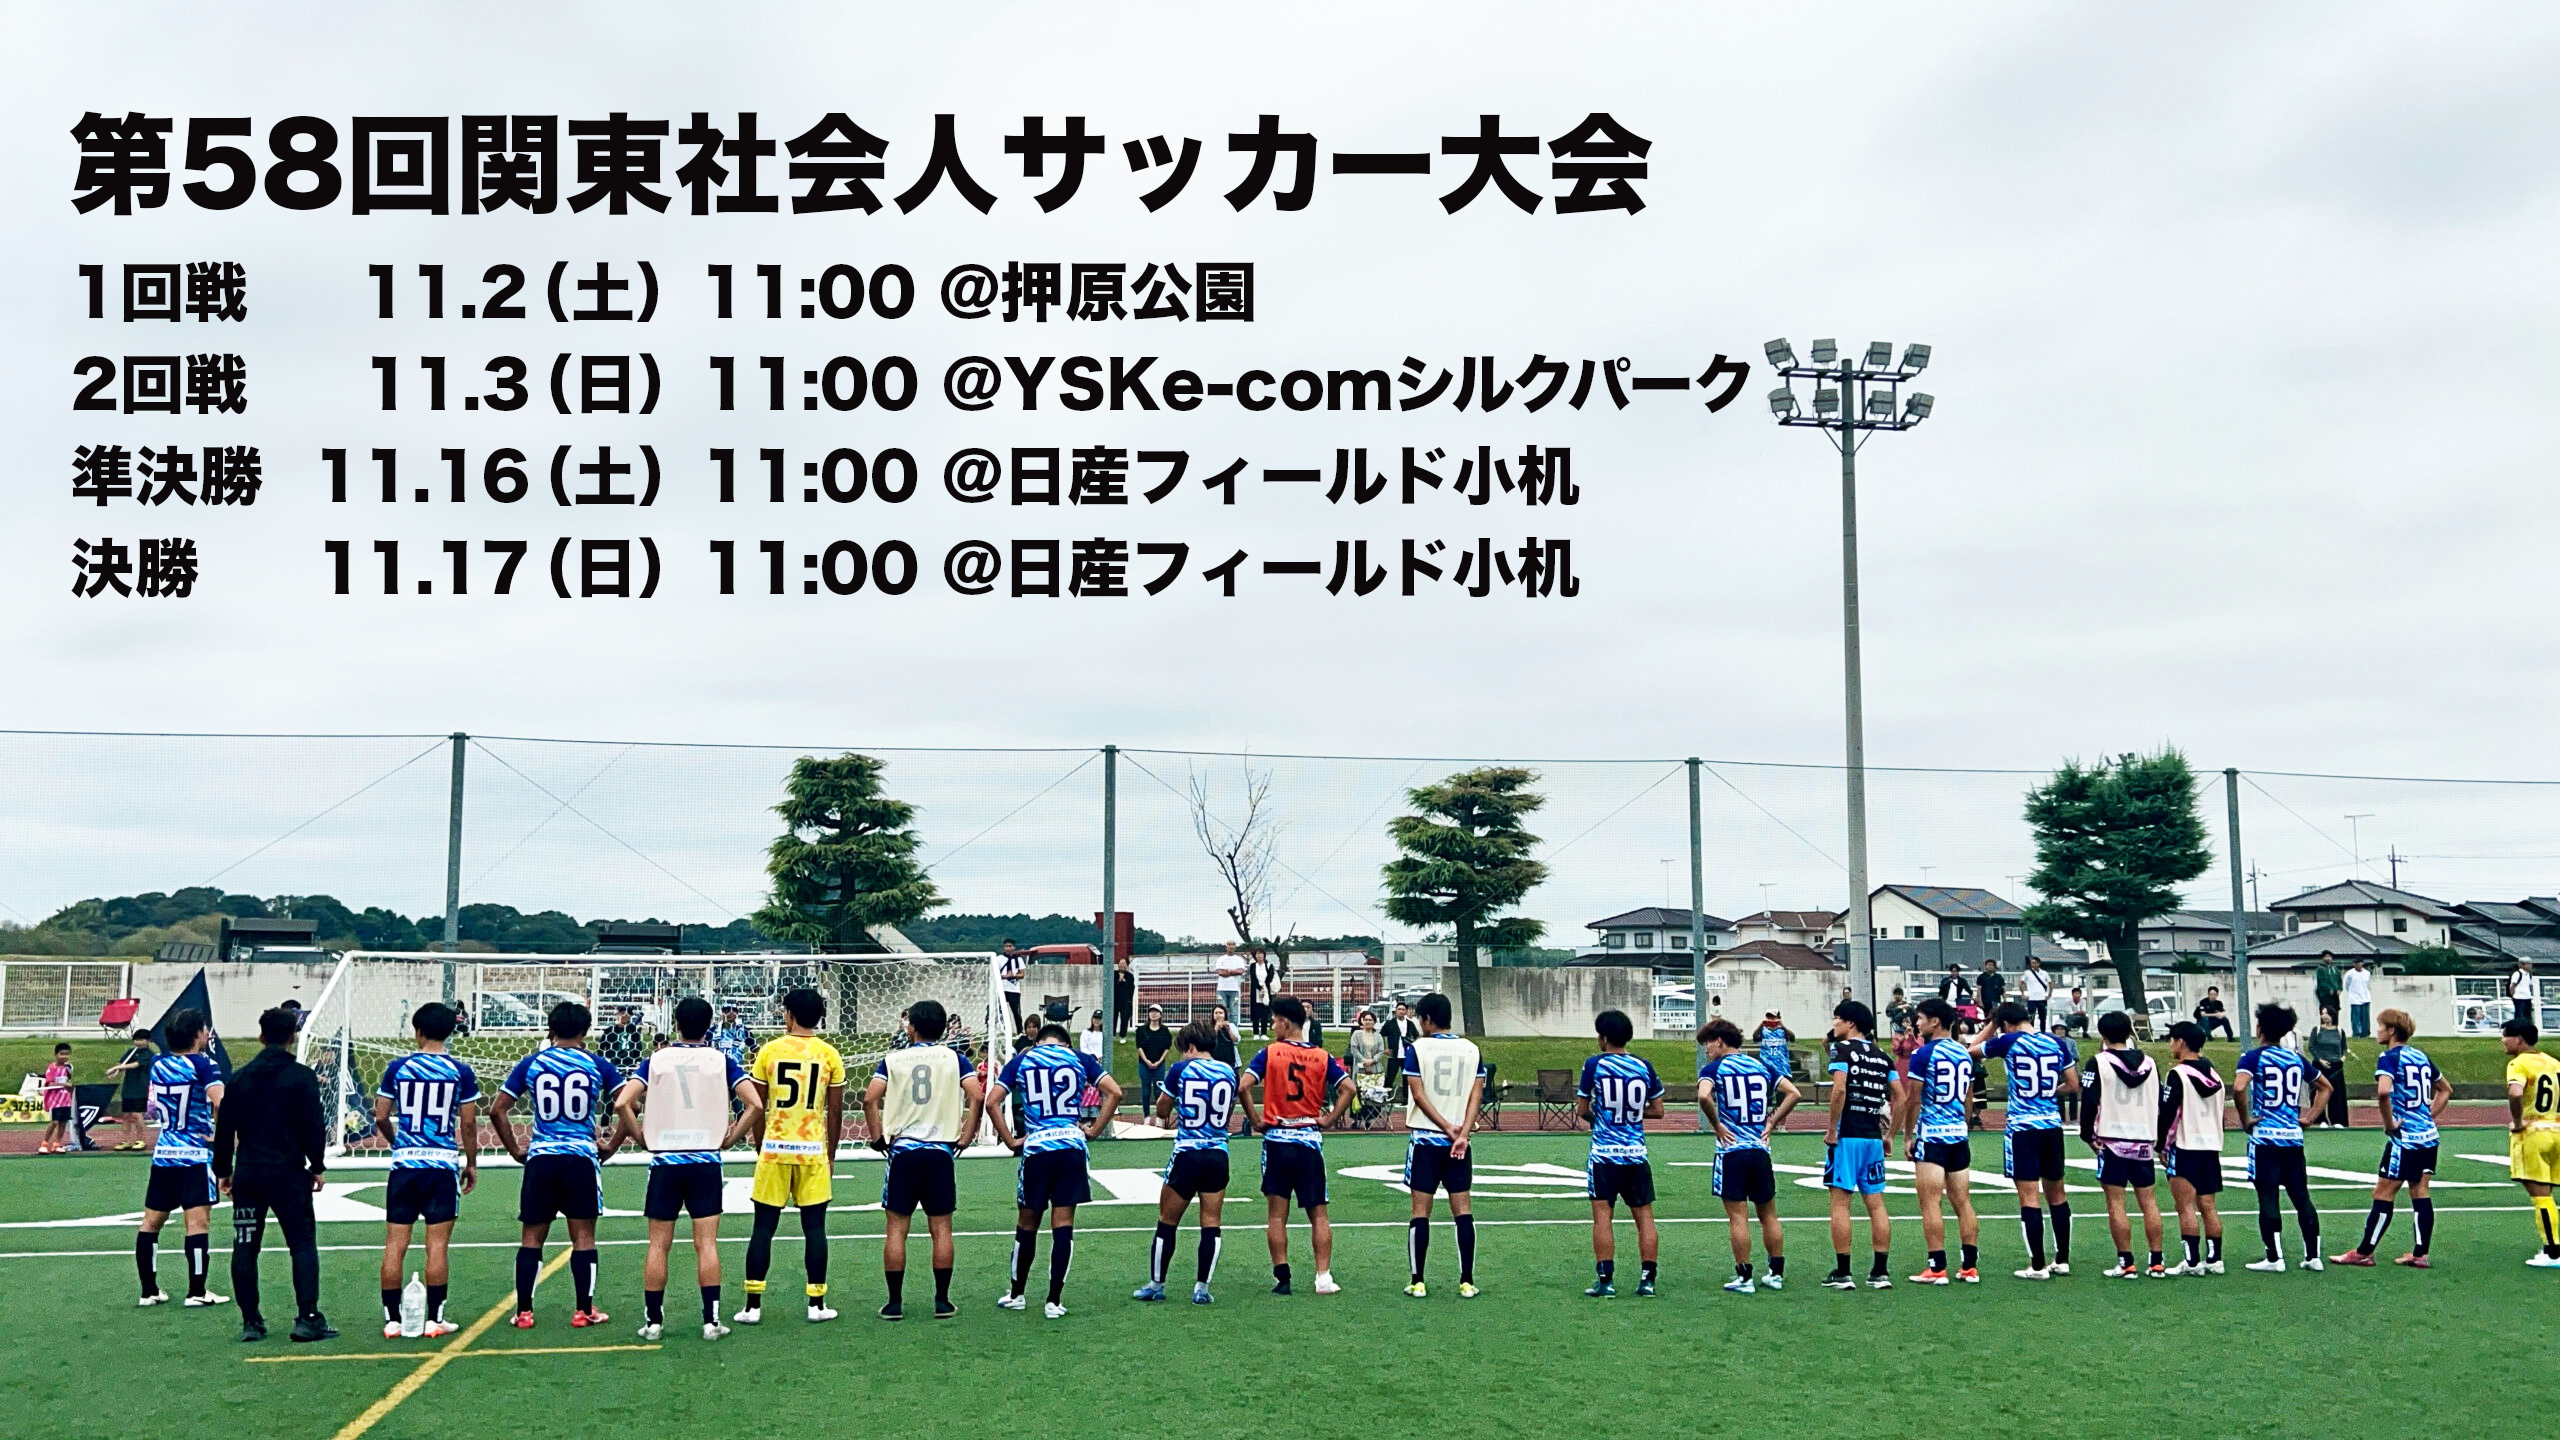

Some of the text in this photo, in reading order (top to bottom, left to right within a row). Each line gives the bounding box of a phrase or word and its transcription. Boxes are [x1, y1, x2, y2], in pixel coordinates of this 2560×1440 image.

[536, 1072, 590, 1121] 66
[777, 1062, 819, 1109] 51
[912, 1064, 932, 1105] 8
[1025, 1067, 1079, 1117] 42
[1286, 1062, 1306, 1101] 5
[1723, 1075, 1768, 1123] 43
[1936, 1061, 1973, 1103] 36
[2016, 1055, 2059, 1098] 35
[2264, 1066, 2302, 1107] 39
[2405, 1065, 2432, 1108] 56
[153, 1084, 191, 1131] 57
[400, 1081, 455, 1133] 44
[1185, 1081, 1232, 1128] 59
[1601, 1077, 1646, 1124] 49
